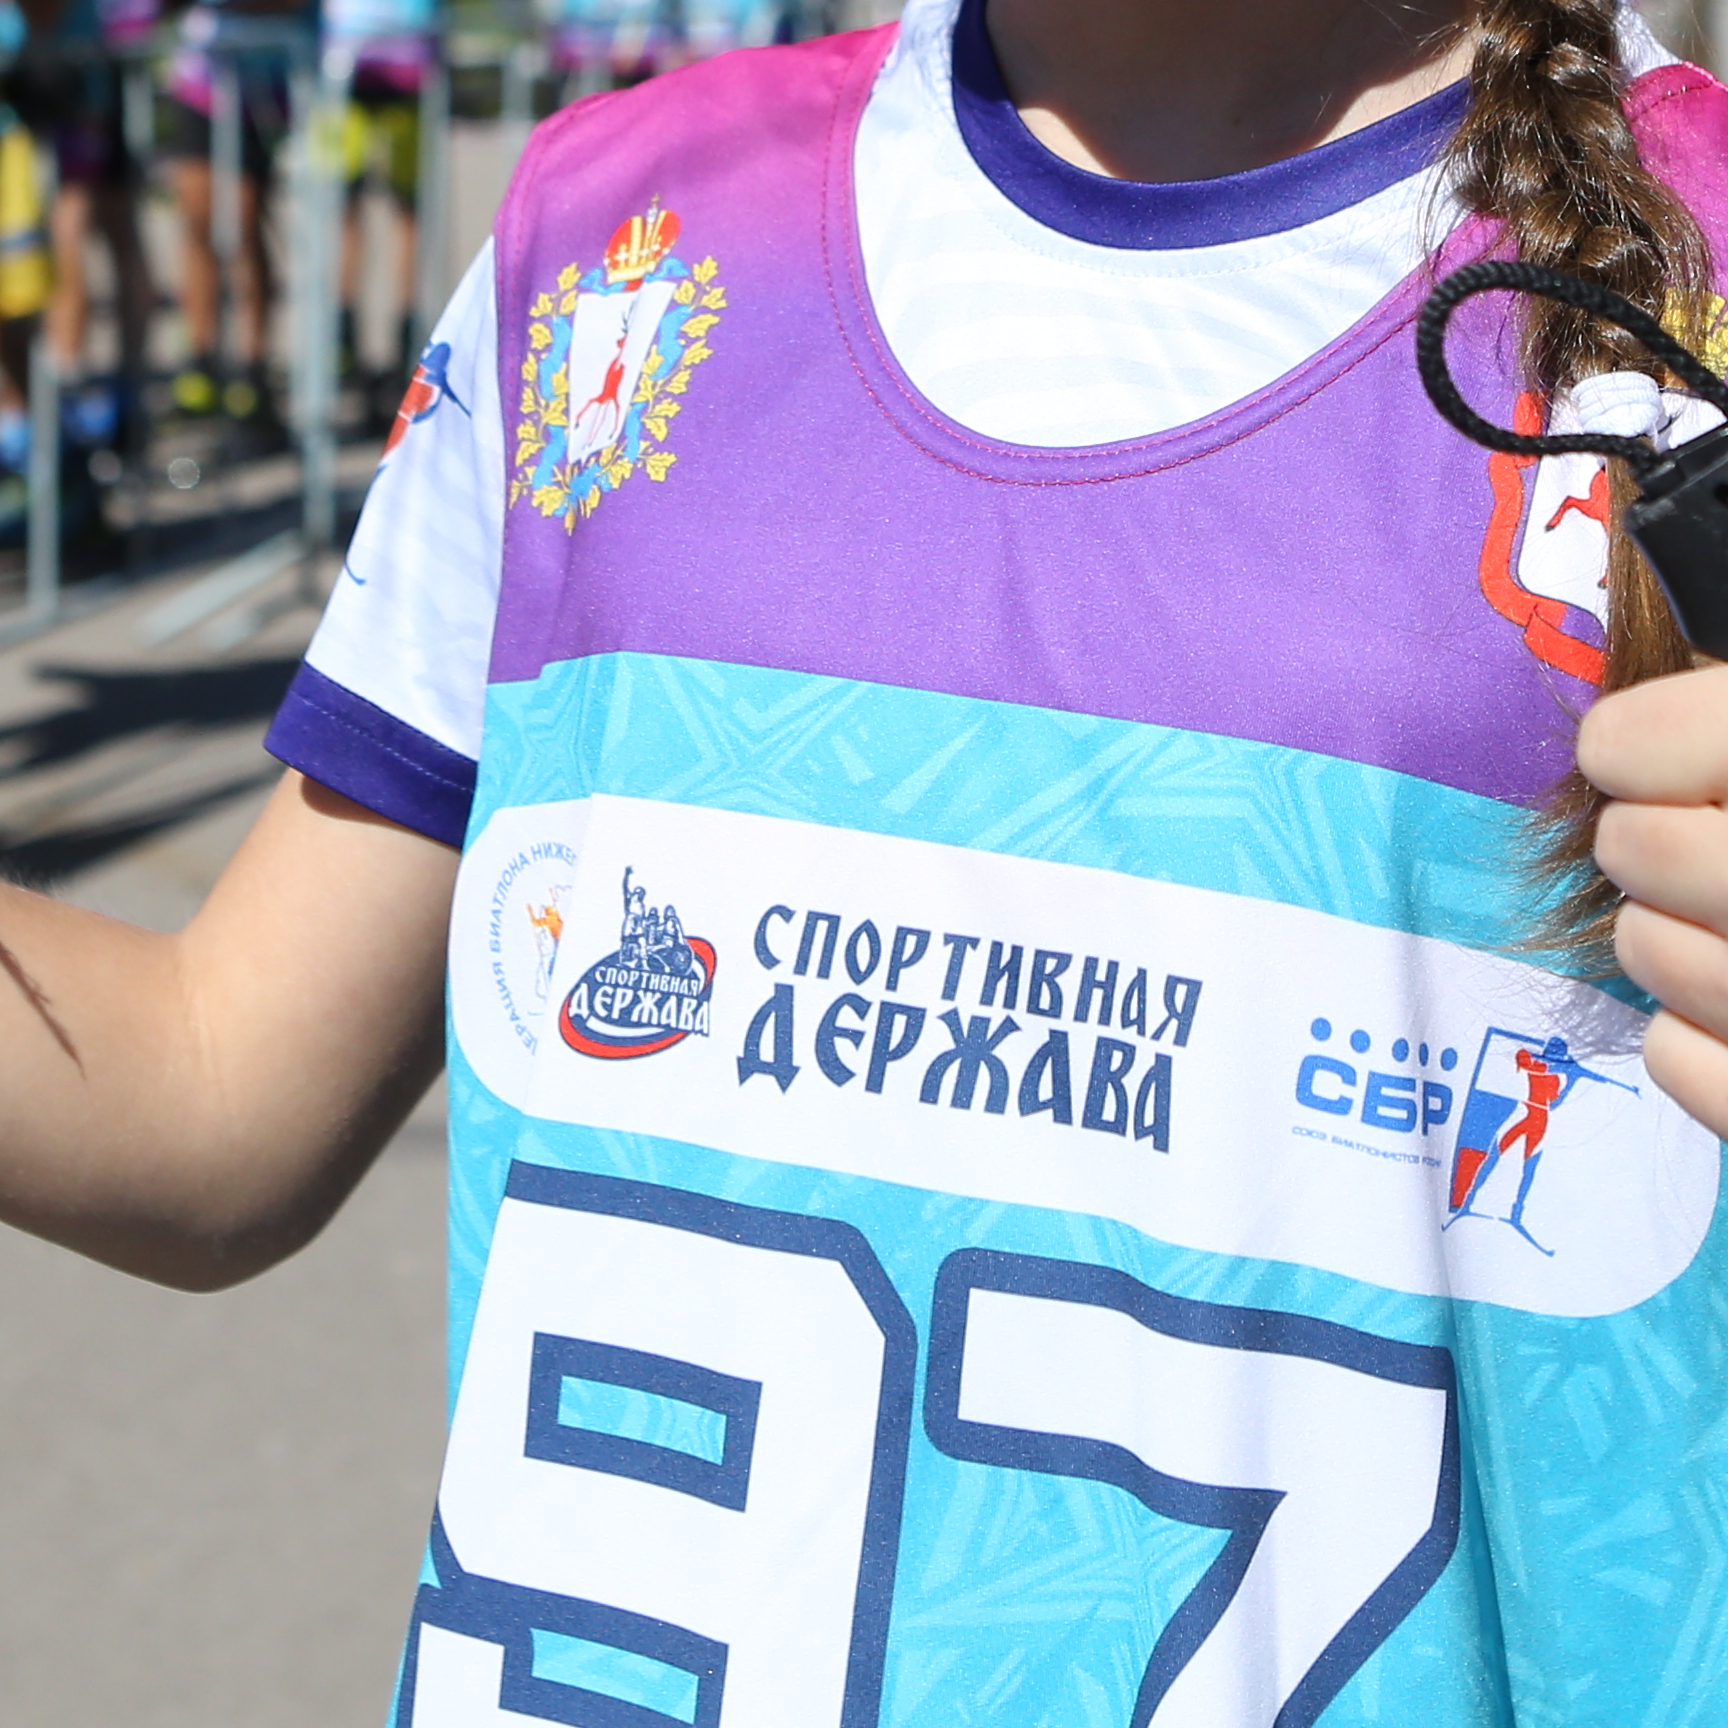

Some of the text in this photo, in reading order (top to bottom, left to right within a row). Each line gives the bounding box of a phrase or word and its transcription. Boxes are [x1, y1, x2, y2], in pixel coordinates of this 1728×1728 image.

[489, 852, 531, 953] БИАТЛОНА
[568, 982, 710, 1038] ДЕРЖАВА
[594, 965, 700, 997] СПОРТИВНАЯ
[754, 904, 1203, 1048] СПОРТИВНАЯ
[736, 982, 1174, 1154] ДЕРЖАВА
[1295, 1054, 1453, 1137] СБР
[392, 1159, 1460, 1728] 97
